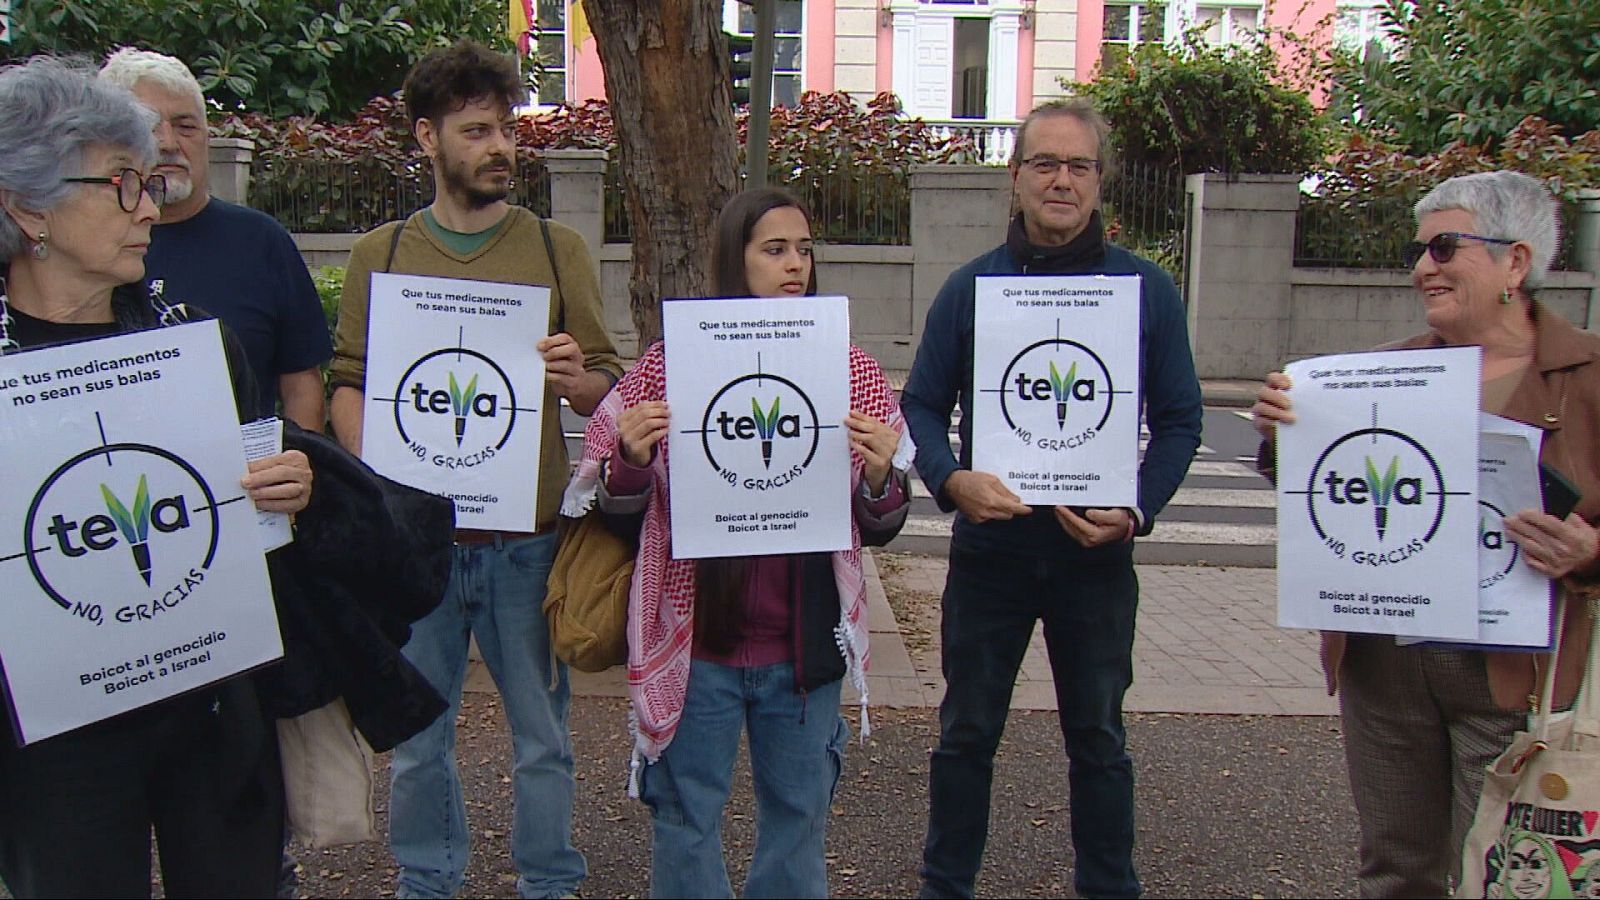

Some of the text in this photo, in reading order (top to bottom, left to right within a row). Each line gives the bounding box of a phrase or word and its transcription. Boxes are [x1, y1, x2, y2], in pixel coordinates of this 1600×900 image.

[401, 288, 522, 306] Que tus medicamentos
[1002, 288, 1022, 297] Que
[1042, 288, 1114, 296] medicamentos
[416, 302, 506, 316] no sean sus balas
[1074, 299, 1099, 307] balas
[699, 319, 815, 330] Que tus medicamentos
[714, 333, 727, 341] no
[729, 332, 752, 340] sean
[774, 330, 801, 339] balas
[0, 347, 181, 390] ue tus medicamentos
[13, 369, 161, 406] no sean sus balas
[1015, 427, 1096, 452] NO, GRACIAS
[409, 441, 495, 470] NO, GRACIAS
[720, 465, 803, 491] NO, GRACIAS
[1008, 471, 1100, 481] Boicot al genocidio
[1020, 482, 1050, 491] Boicot
[1061, 483, 1088, 491] Israel
[457, 505, 484, 514] Israel
[715, 510, 809, 522] Boicot al genocidio
[728, 523, 760, 533] Boicot
[770, 521, 796, 531] Israel
[1325, 537, 1424, 567] NO, GRACIAS
[72, 568, 205, 626] NO, GRACIAS
[1319, 590, 1431, 605] Boicot al genocidio
[1333, 604, 1415, 617] Boicot a Israel
[80, 631, 226, 686] Boicot al genocidio
[104, 650, 211, 694] Boicot a Israel
